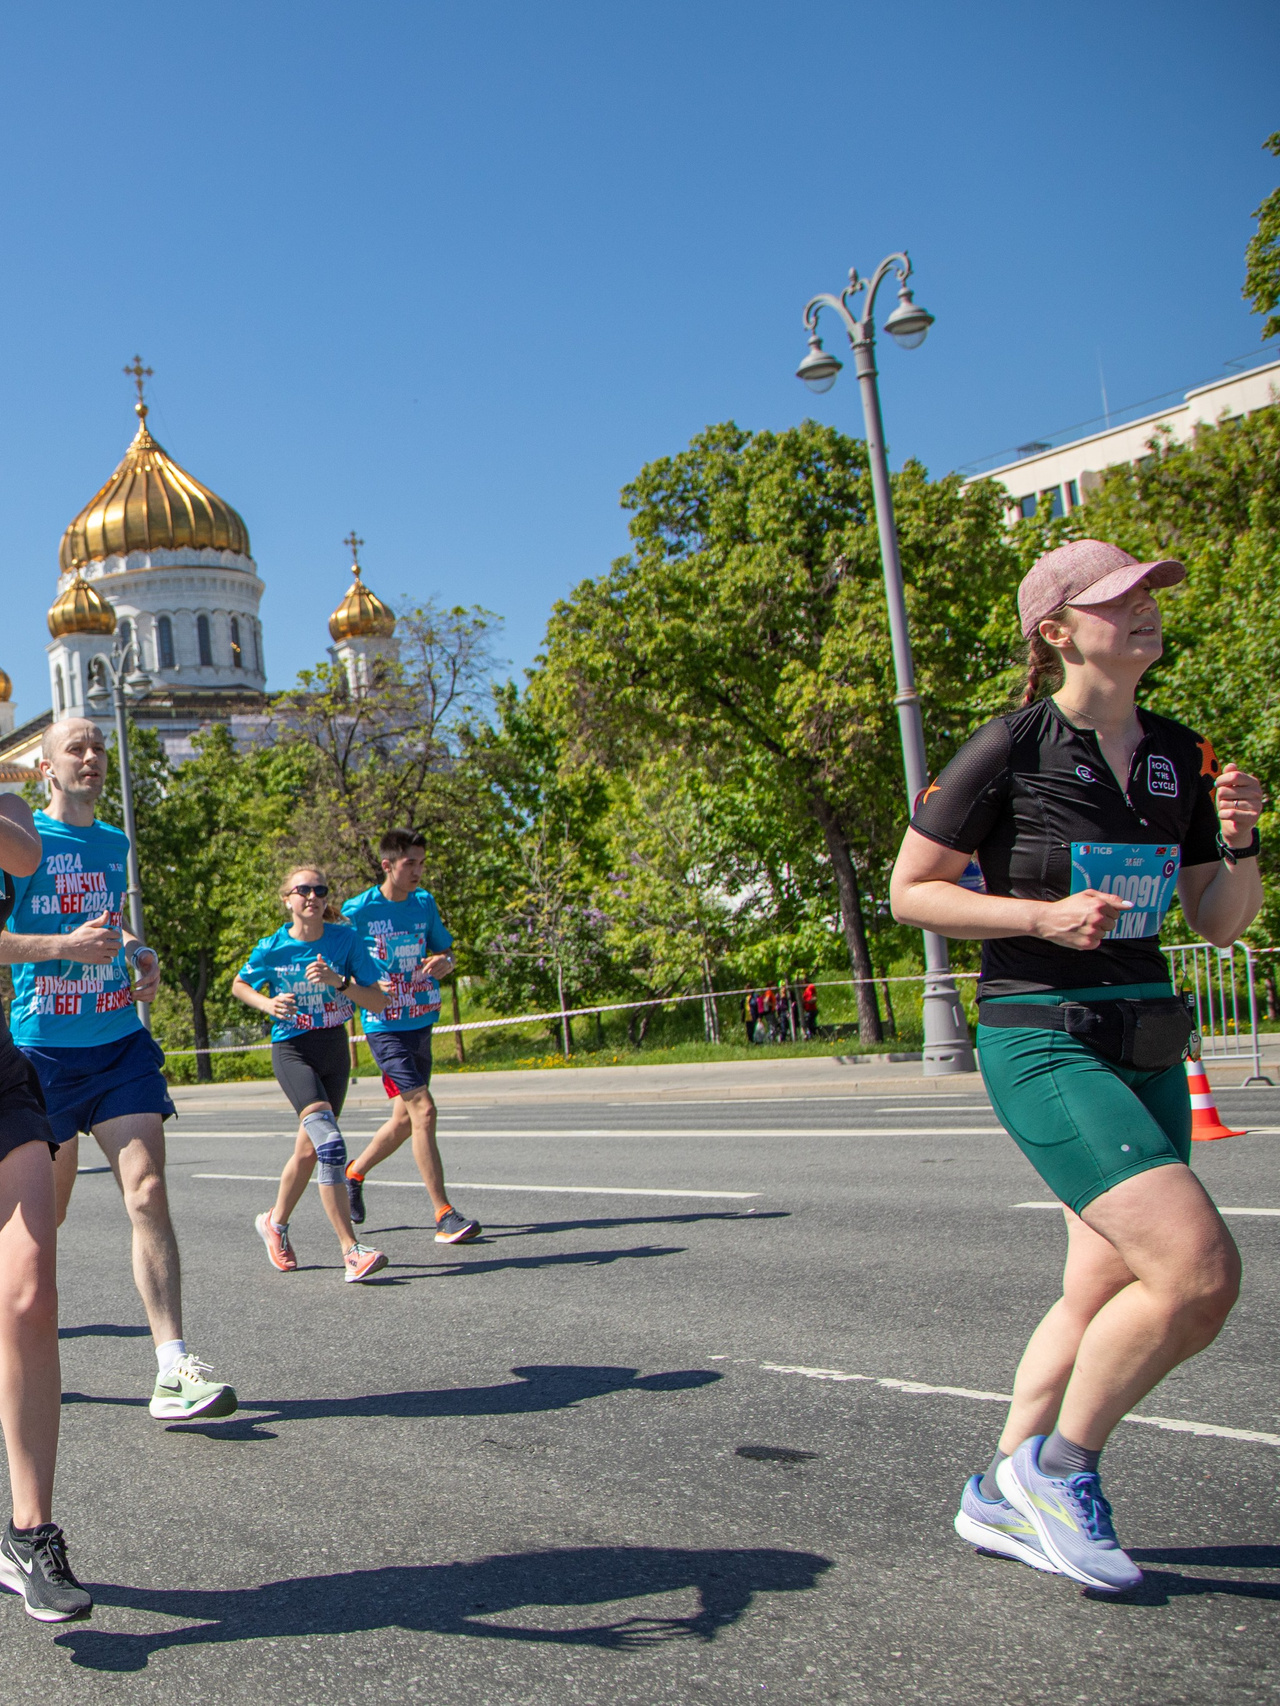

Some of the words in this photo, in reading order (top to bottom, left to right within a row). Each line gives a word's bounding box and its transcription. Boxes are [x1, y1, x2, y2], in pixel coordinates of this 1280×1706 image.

[1151, 761, 1170, 772] ROCK
[1155, 771, 1170, 780] THE
[1151, 781, 1175, 791] CYCLE
[1093, 846, 1113, 855] ПСБ
[46, 852, 83, 875] 2024
[1164, 861, 1174, 875] C
[55, 872, 108, 894] #МЕЧТА
[31, 891, 115, 915] #ЗАБЕГ2024
[367, 918, 394, 935] 2024
